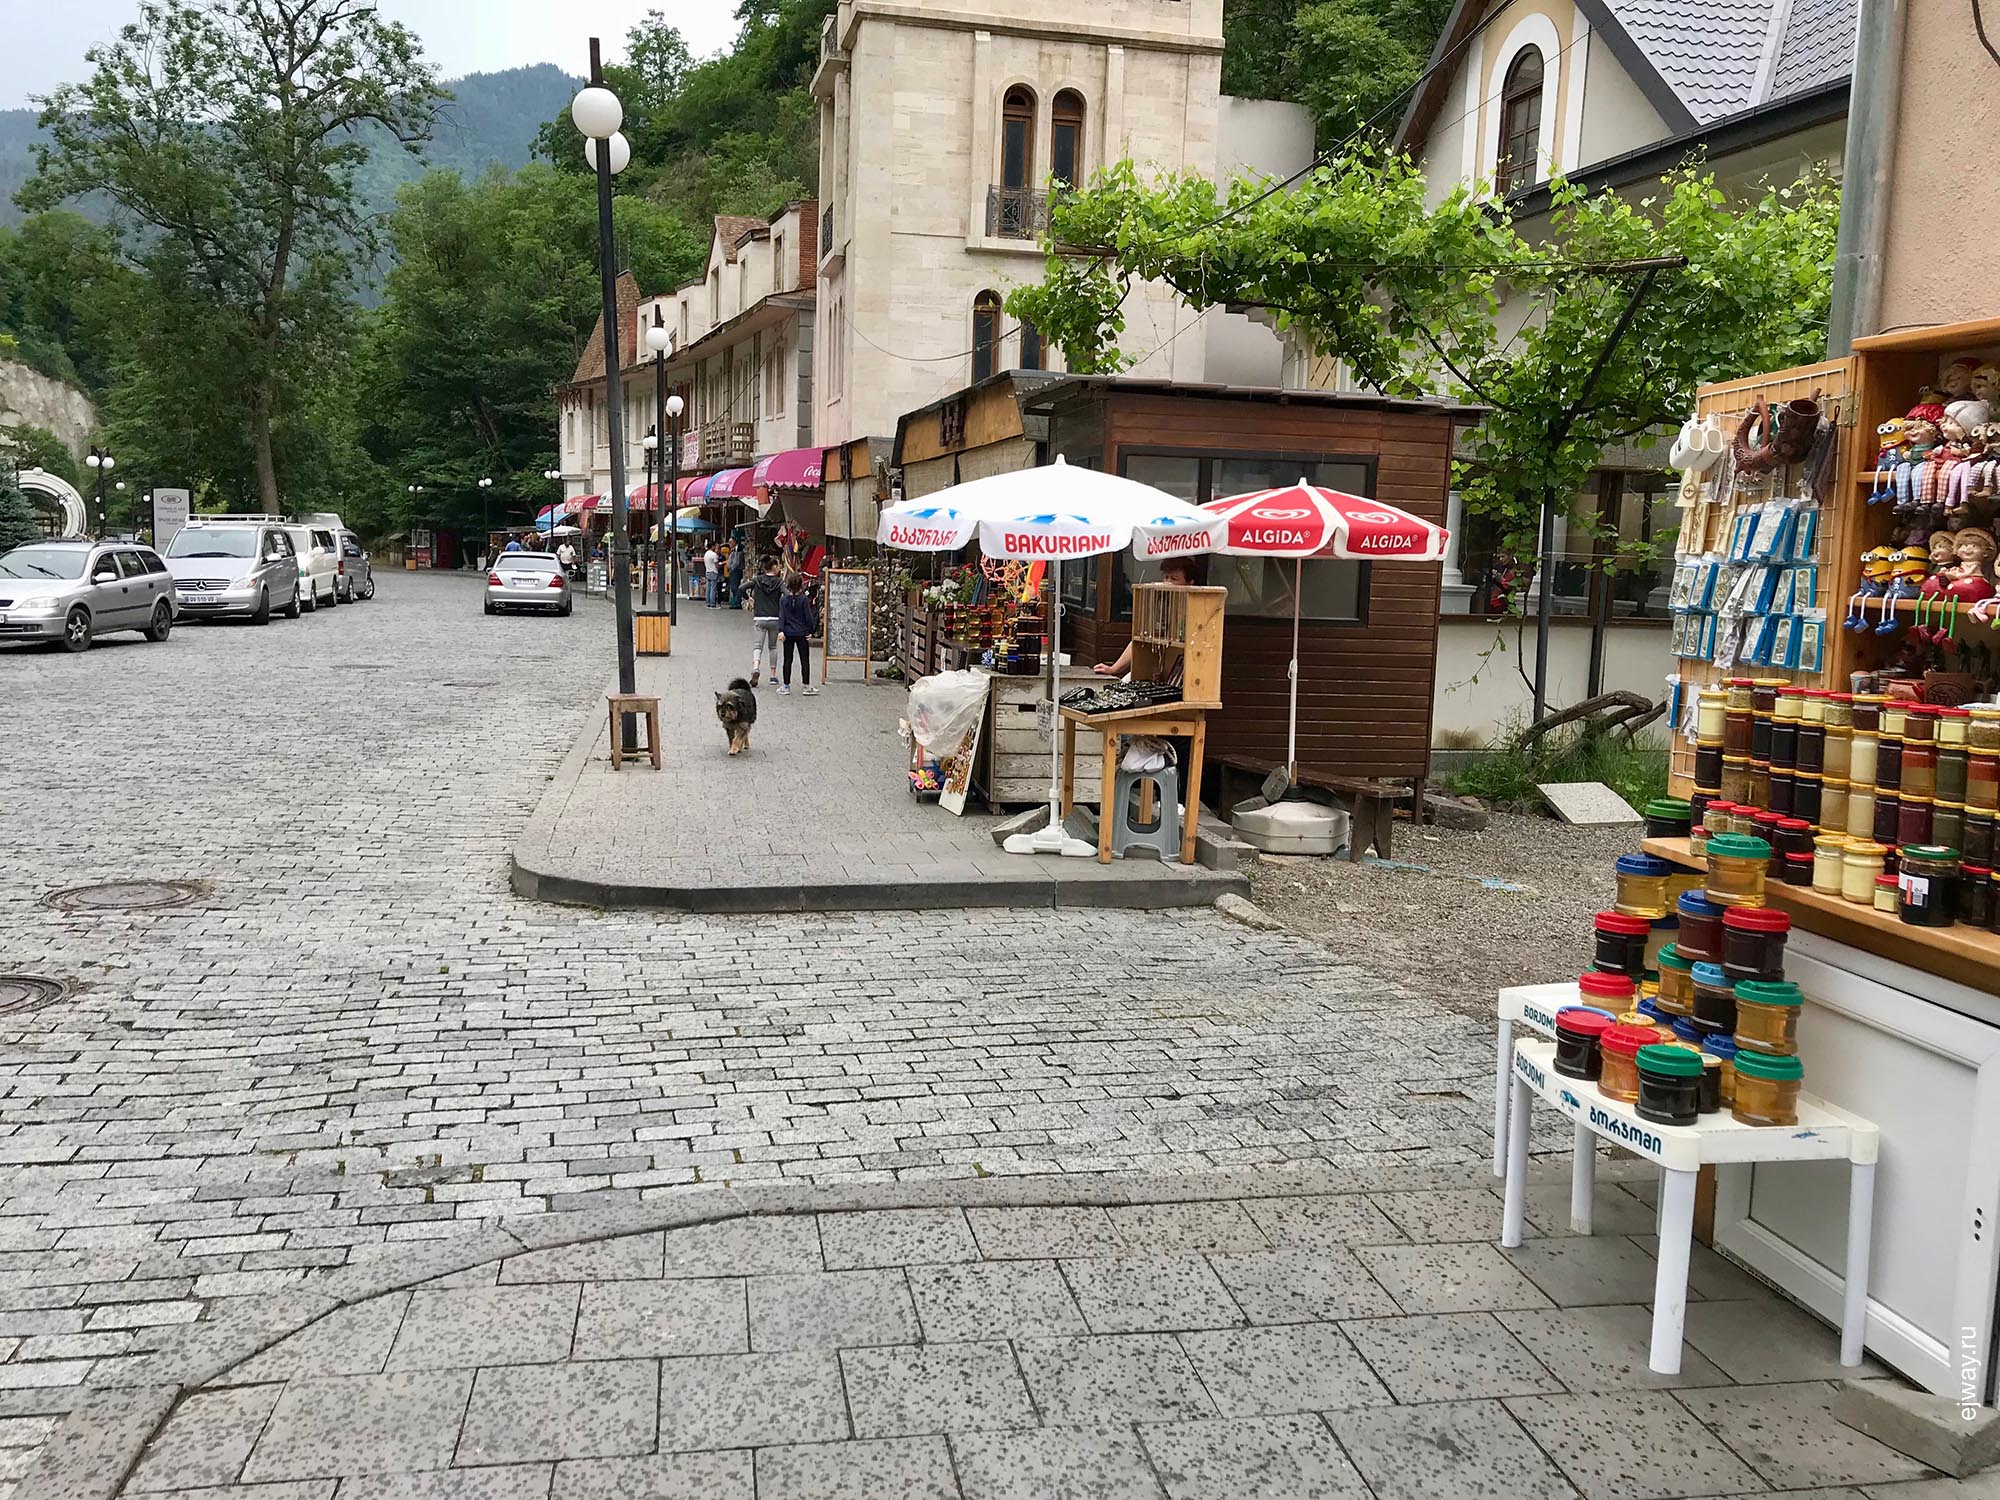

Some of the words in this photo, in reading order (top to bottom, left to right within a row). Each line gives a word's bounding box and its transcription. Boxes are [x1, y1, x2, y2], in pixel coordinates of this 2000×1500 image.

[890, 525, 957, 546] ბაკურიანი
[1005, 533, 1111, 554] BAKURIANI
[1524, 1005, 1555, 1030] BORJOMI
[1516, 1051, 1545, 1090] BORJOMI
